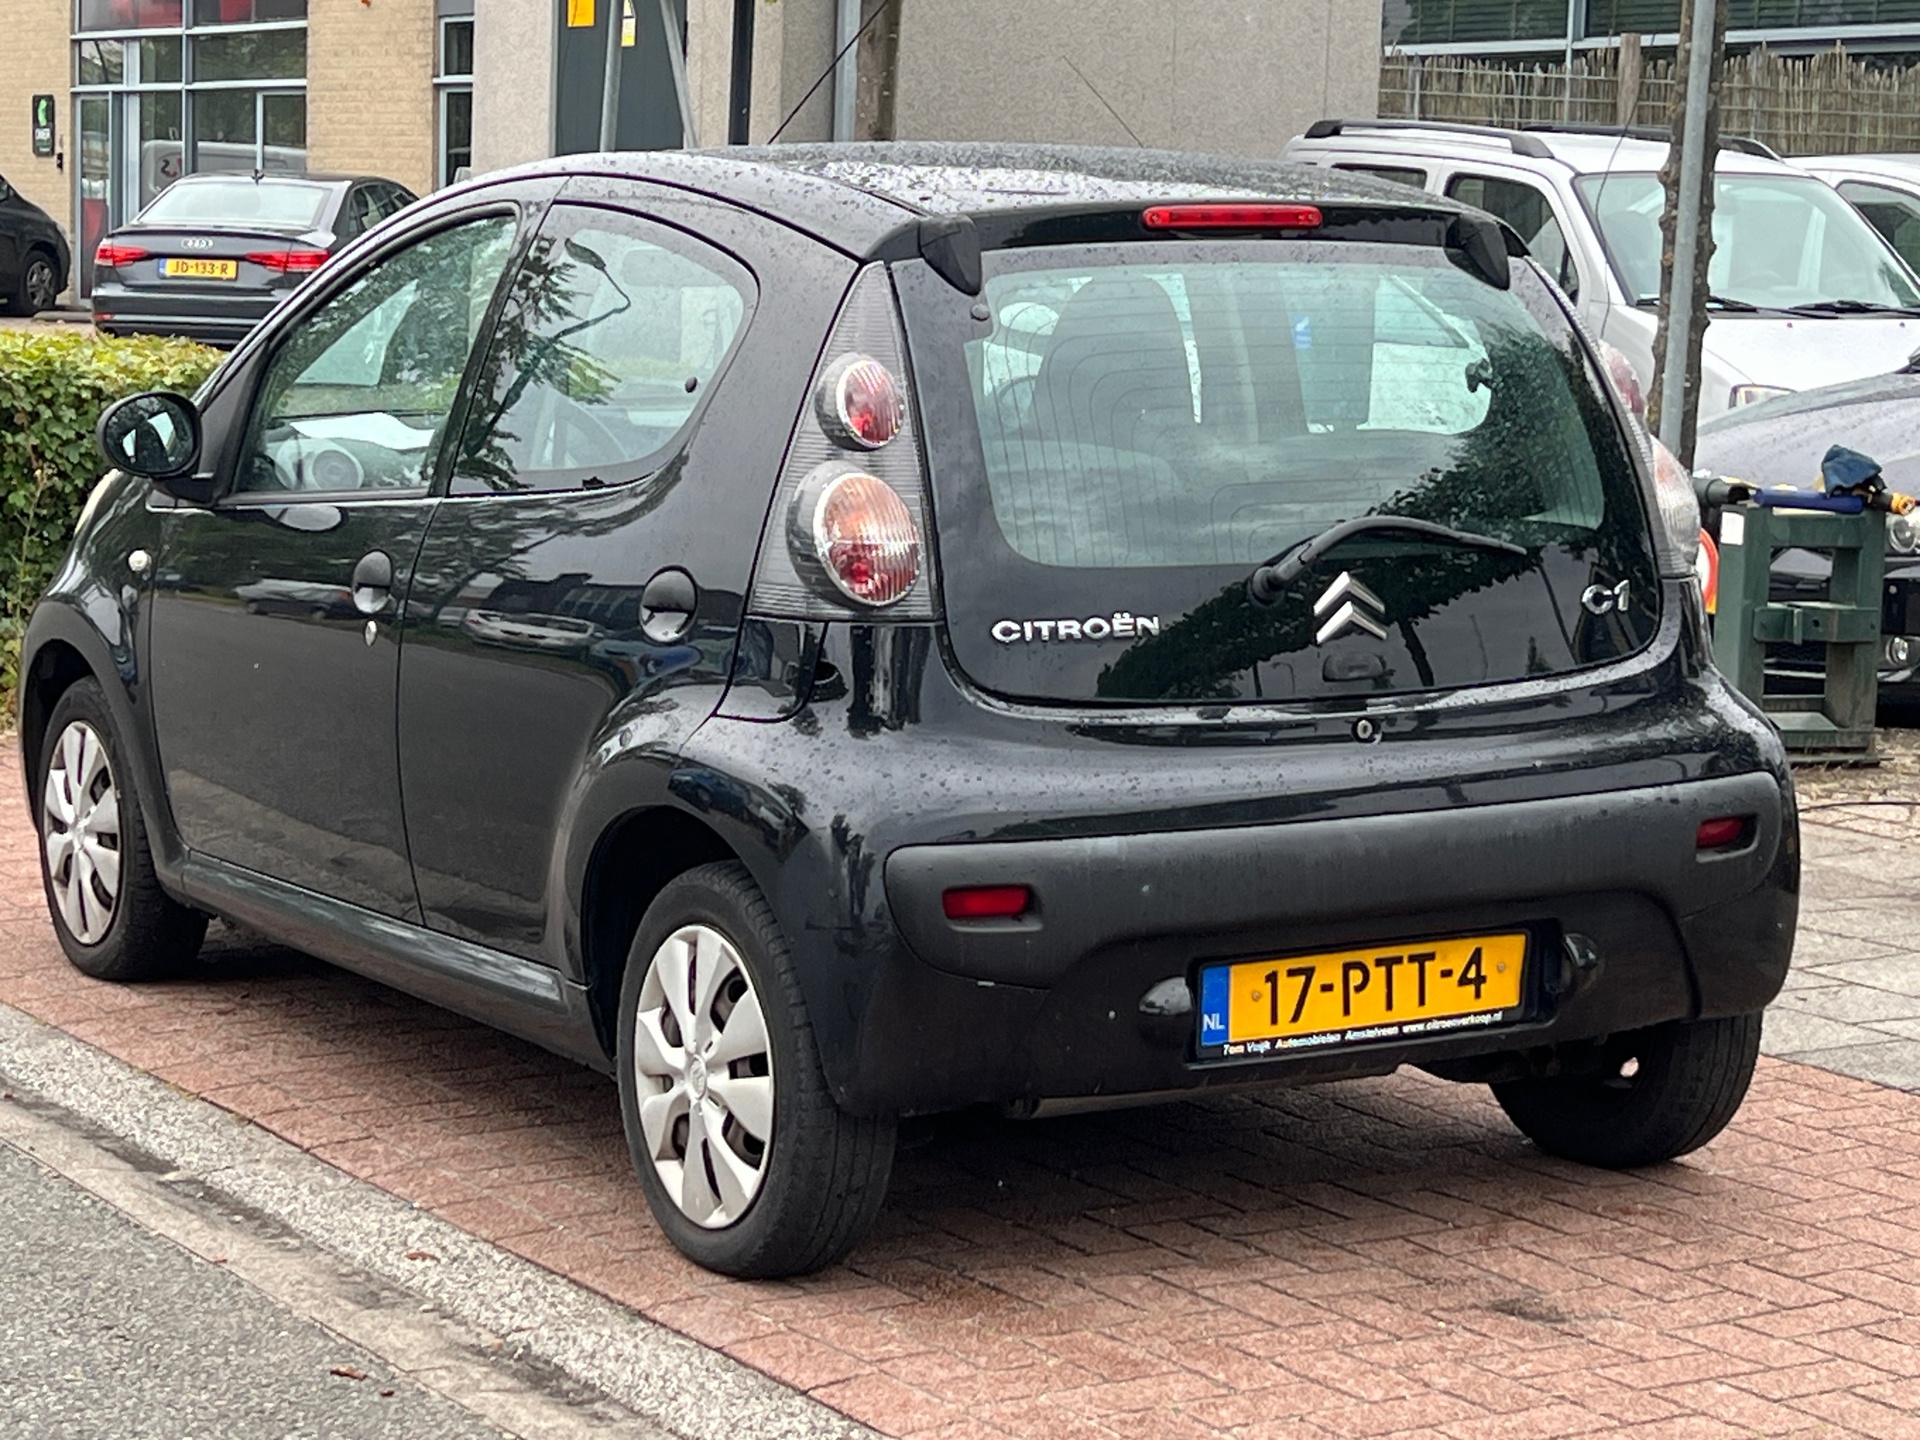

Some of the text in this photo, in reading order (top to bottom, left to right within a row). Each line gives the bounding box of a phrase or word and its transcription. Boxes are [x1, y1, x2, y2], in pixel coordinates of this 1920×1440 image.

[172, 261, 228, 275] JD-133-R
[1582, 579, 1629, 614] C1
[992, 612, 1160, 643] CITROËN
[1264, 946, 1487, 1026] 17-PTT-4
[1202, 1013, 1226, 1032] NL
